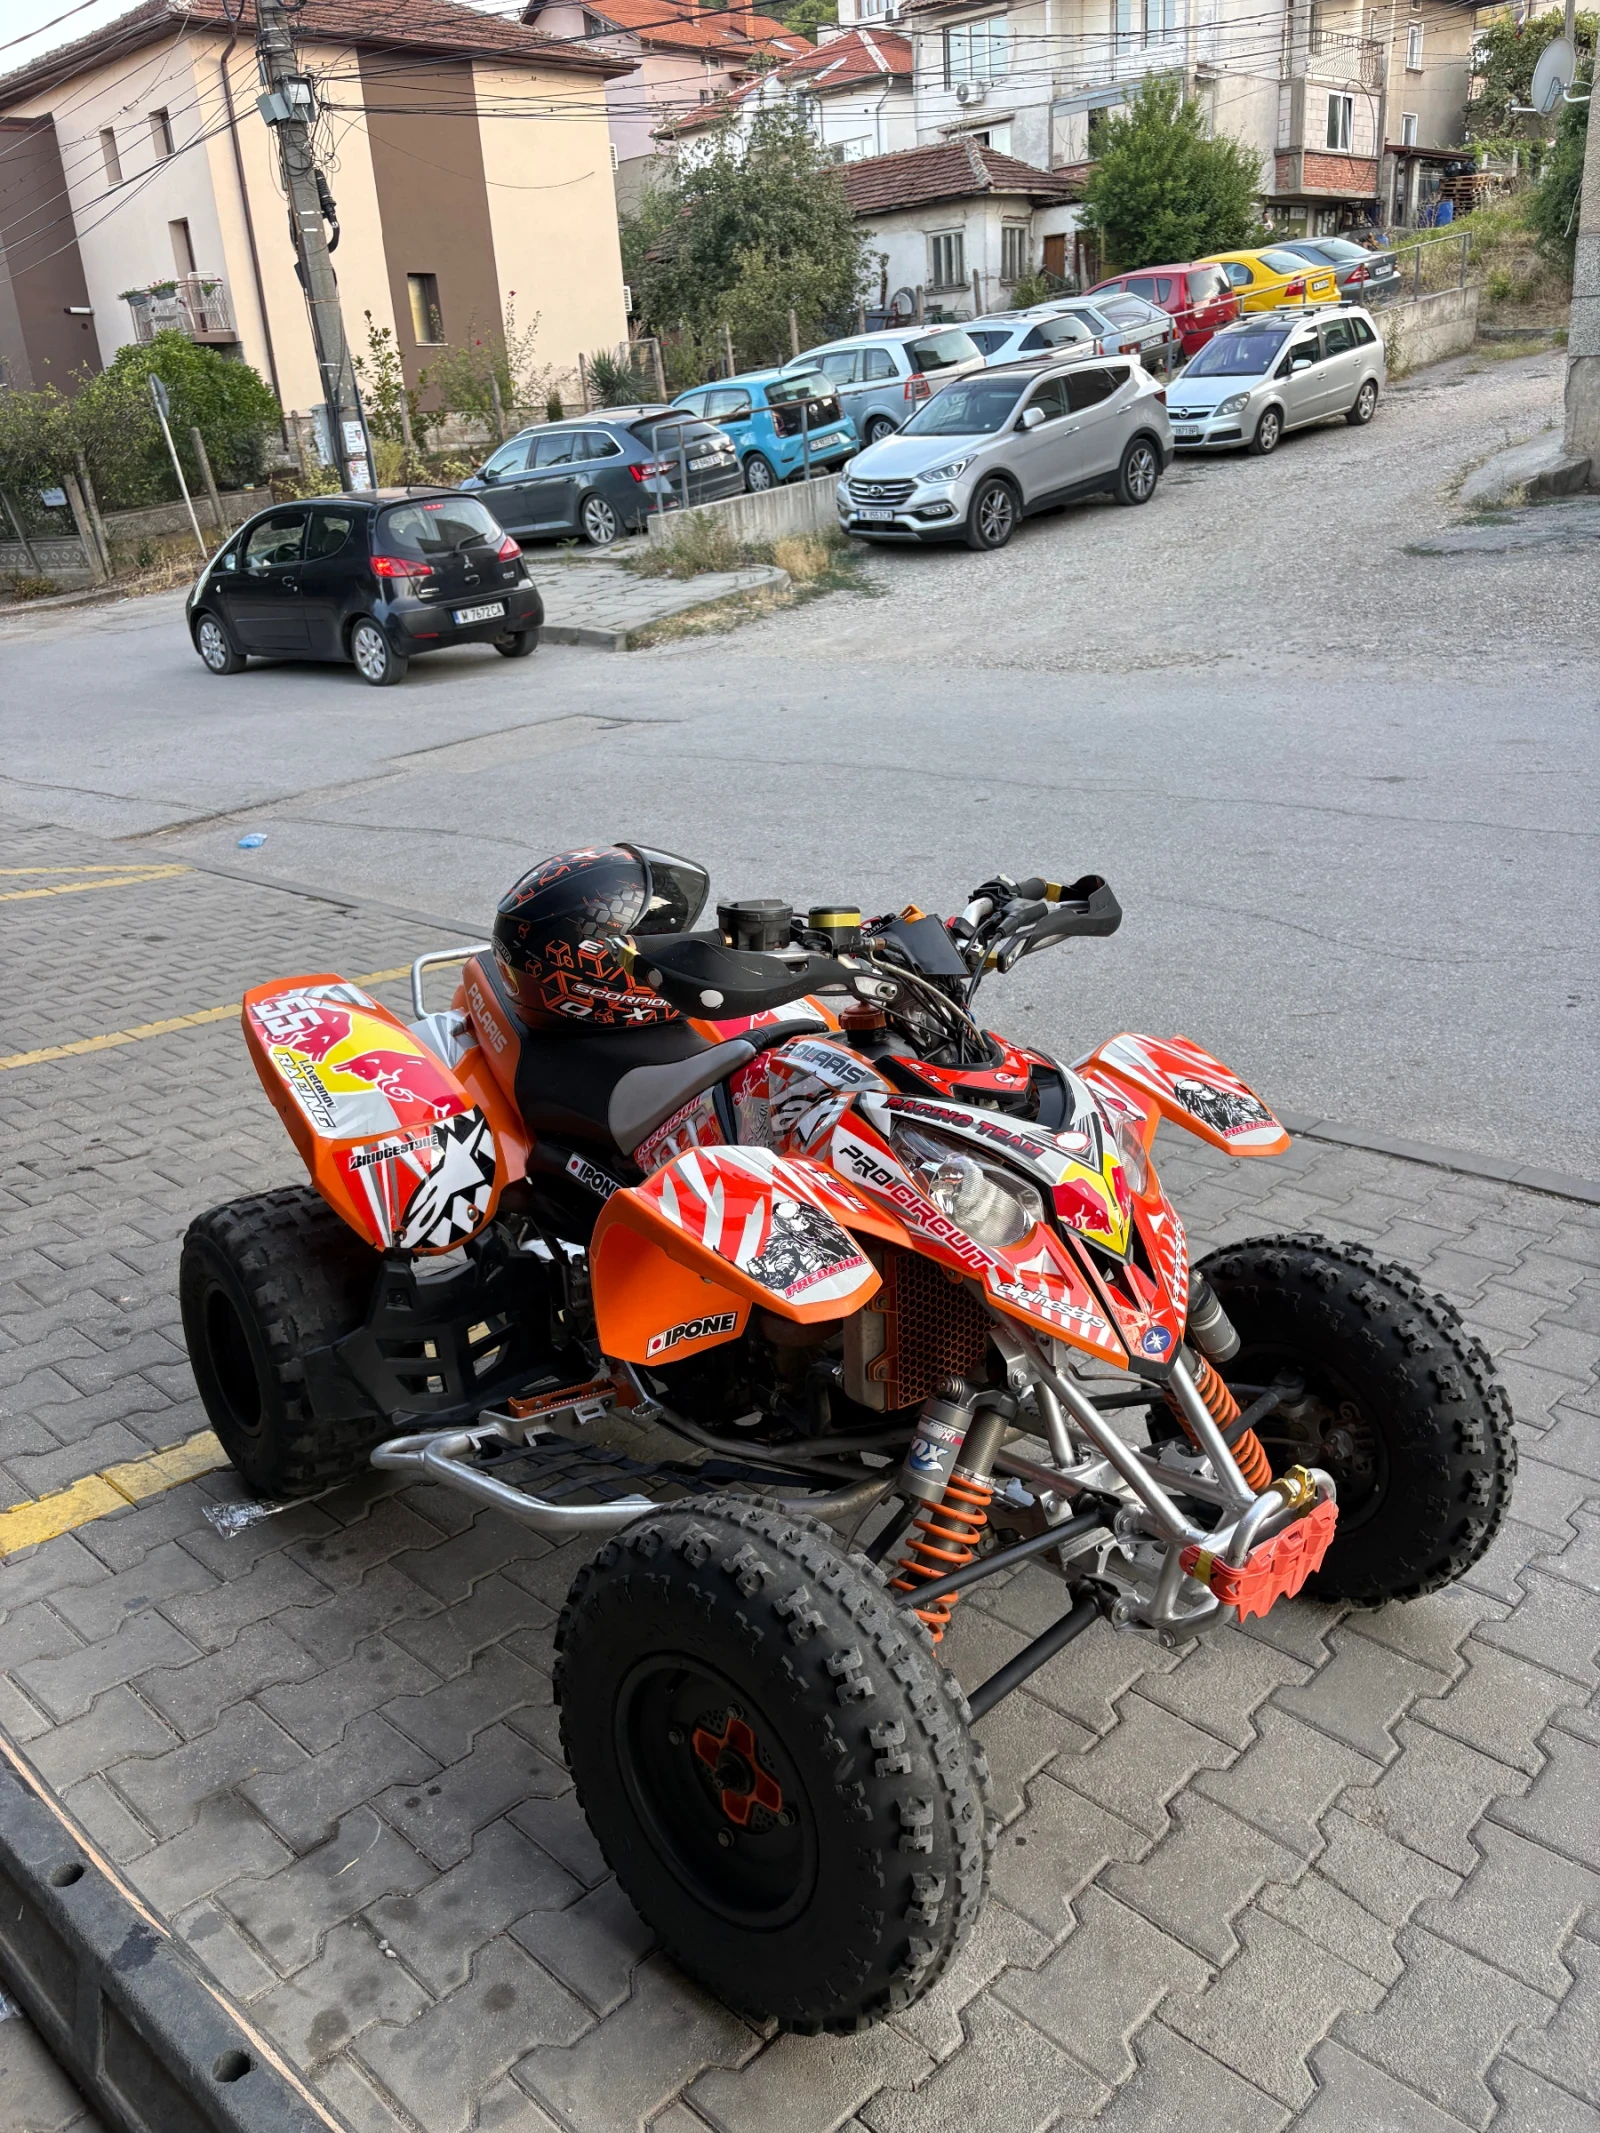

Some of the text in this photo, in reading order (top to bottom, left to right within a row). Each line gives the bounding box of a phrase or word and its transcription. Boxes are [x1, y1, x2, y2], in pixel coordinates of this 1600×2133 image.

[467, 982, 508, 1054] POLARIS
[777, 1043, 868, 1085] POLARIS
[273, 1051, 337, 1129] RACING
[350, 1133, 439, 1170] BRIDGESTONE
[880, 1096, 1048, 1161] RACING TEAM
[577, 1159, 624, 1200] IPON
[839, 1145, 894, 1187] PRO
[889, 1183, 1000, 1270] CIRCUIT
[784, 1255, 867, 1299] PREDATOR
[997, 1281, 1087, 1329] alpinestars
[664, 1313, 736, 1349] IPONE
